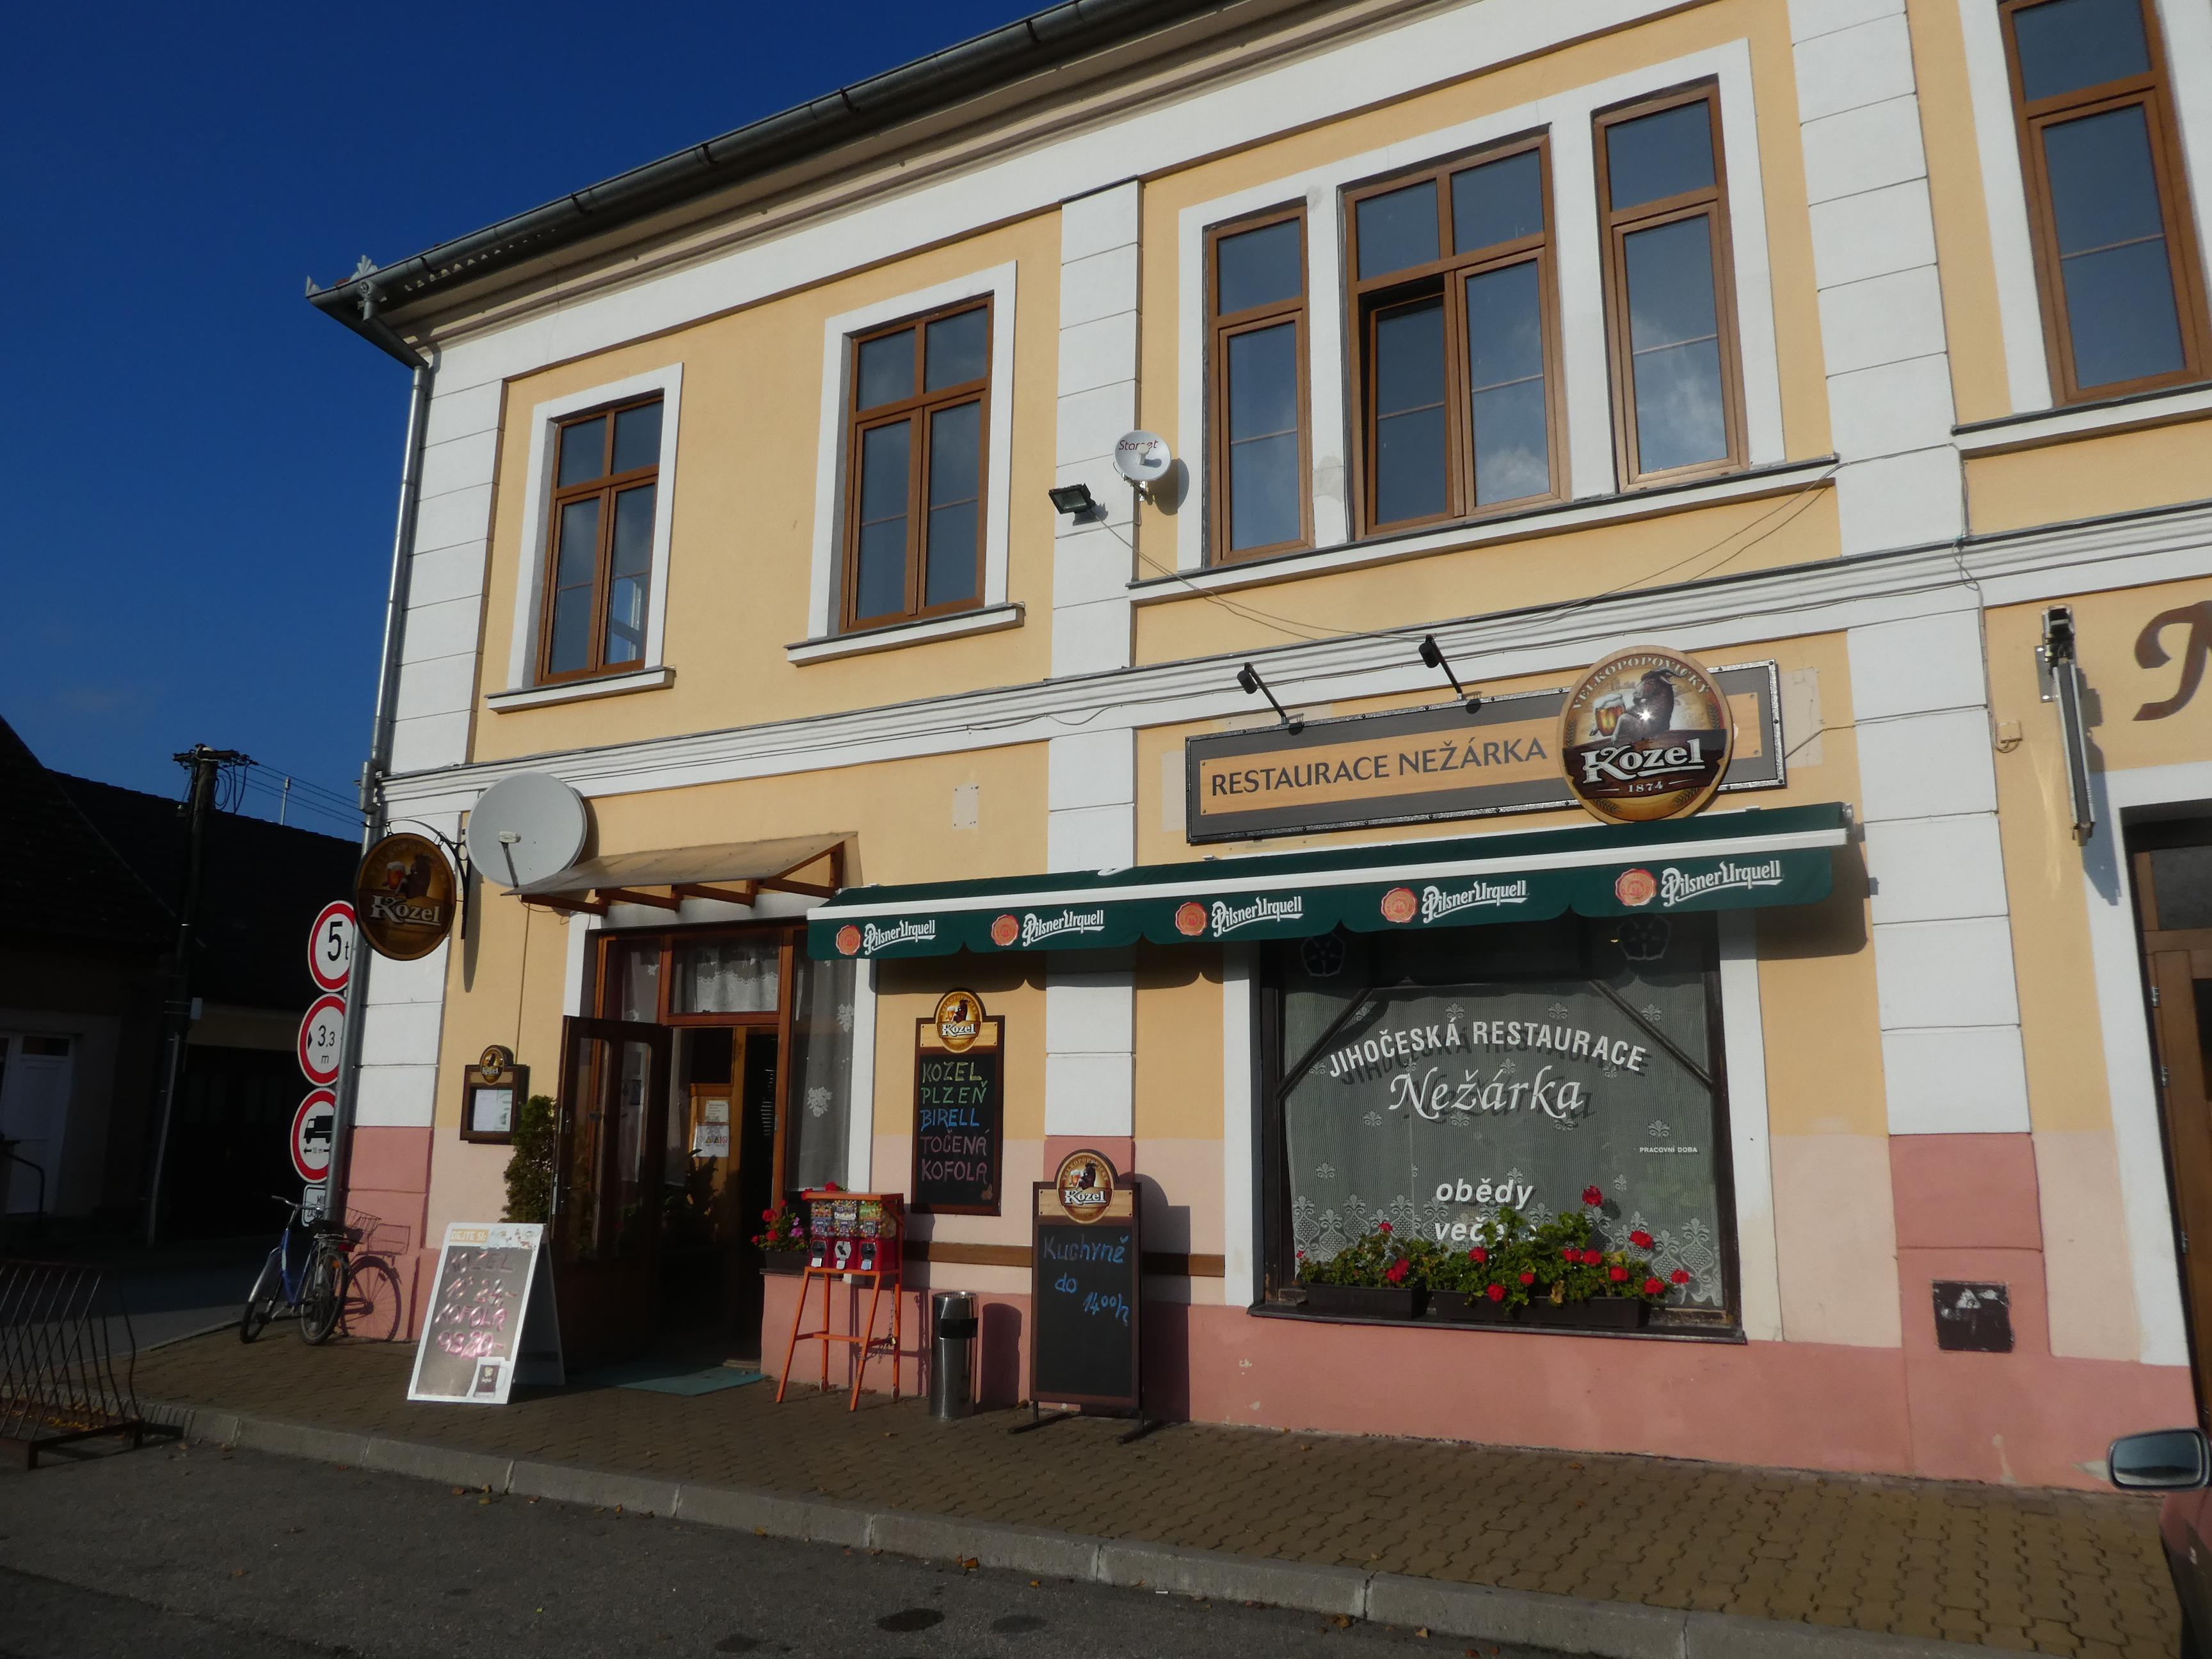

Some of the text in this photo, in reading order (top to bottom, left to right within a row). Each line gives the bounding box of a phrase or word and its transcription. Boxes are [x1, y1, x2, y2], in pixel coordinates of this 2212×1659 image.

[1118, 440, 1158, 451] Staret
[1212, 737, 1547, 797] RESTAURACE NEŽÁRKA
[1581, 738, 1705, 784] Kozel
[1628, 781, 1664, 793] 1874
[1661, 860, 1781, 907] Pilsner Urquell
[369, 895, 441, 926] Kozel
[1212, 896, 1303, 938] Pilsner Urquell
[1421, 880, 1527, 924] Pilsner Urquell
[327, 921, 349, 961] 5 t
[863, 920, 936, 955] Pilsner Urquell
[1022, 910, 1105, 947] Pilsner Urquell
[317, 1025, 335, 1048] 3,3
[942, 1023, 975, 1036] Kozel
[321, 1055, 329, 1064] m
[1329, 1017, 1647, 1077] JIHOČESKÁ RESTAURACE
[922, 1061, 982, 1083] KOZEL
[920, 1080, 988, 1104] PLZEŇ
[1388, 1065, 1583, 1120] Nežárka
[919, 1107, 979, 1132] BIRELL
[919, 1128, 990, 1156] TOČENÁ
[922, 1158, 988, 1183] KOFOLA
[1064, 1190, 1106, 1205] Kozel
[1436, 1178, 1534, 1210] obědy
[1043, 1233, 1129, 1263] Kuchyně
[1055, 1272, 1077, 1294] do
